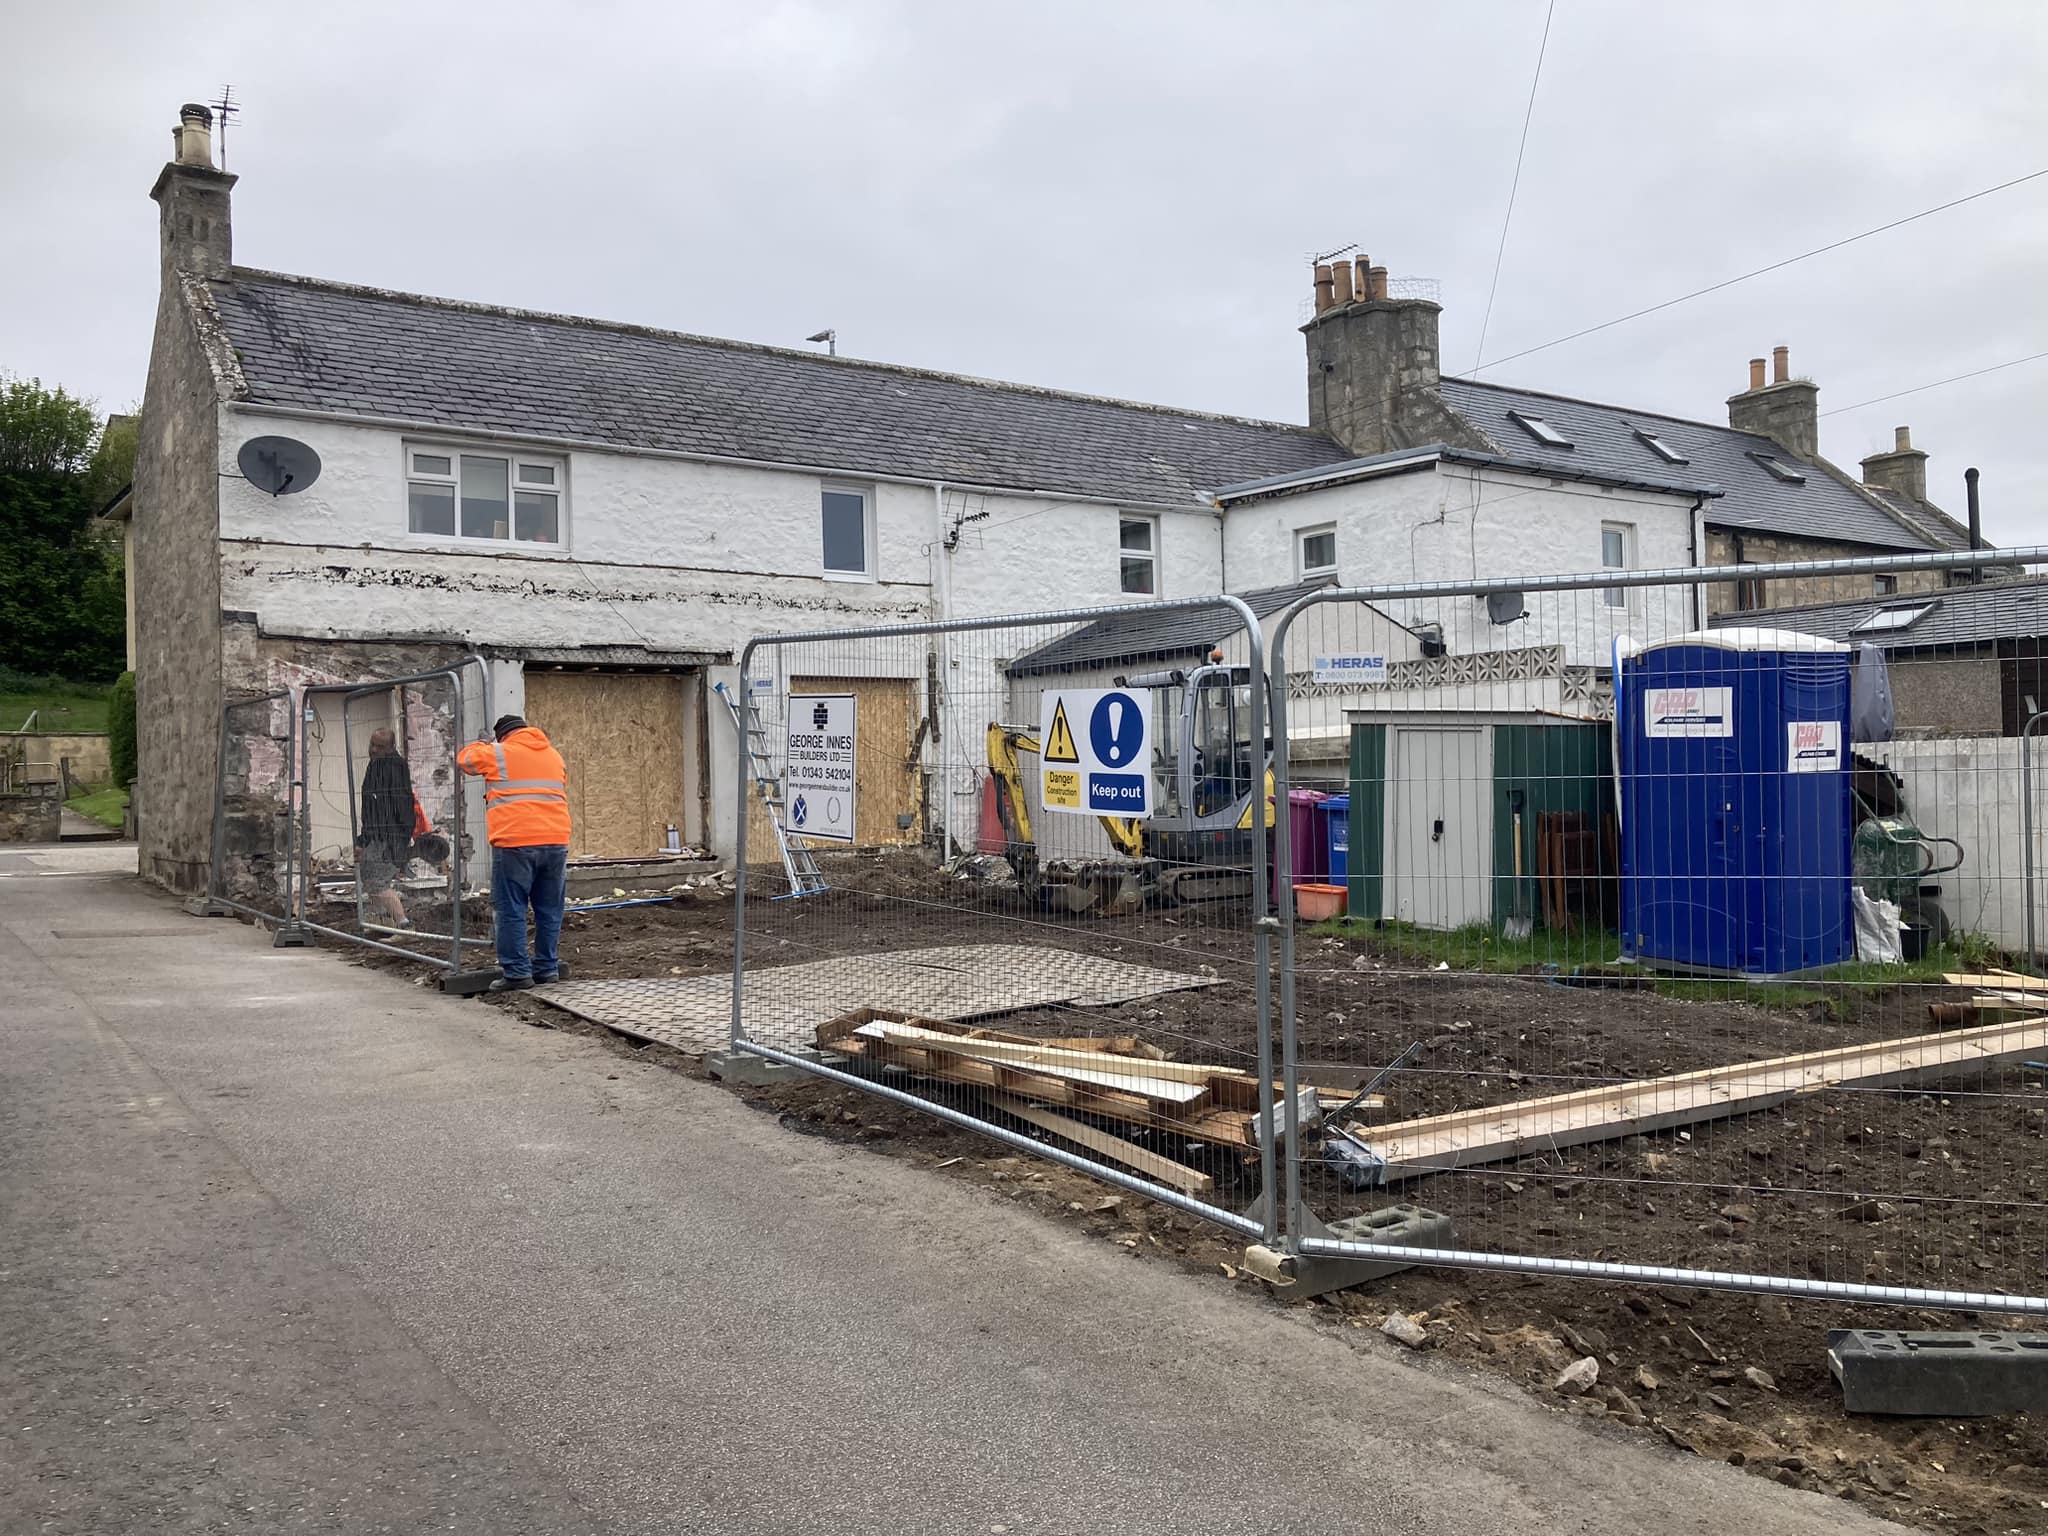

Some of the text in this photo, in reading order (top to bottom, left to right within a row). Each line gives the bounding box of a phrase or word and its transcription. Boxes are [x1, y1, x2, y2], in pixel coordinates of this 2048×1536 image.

[1331, 657, 1384, 669] HERAS
[790, 734, 852, 750] GEORGE INNES
[799, 750, 841, 762] BUILDERS LTD
[801, 766, 824, 779] 01343
[825, 767, 851, 781] 542104
[1049, 771, 1074, 787] Danger
[1047, 786, 1077, 796] Construction
[1091, 783, 1142, 800] Keep out
[1057, 797, 1066, 805] site
